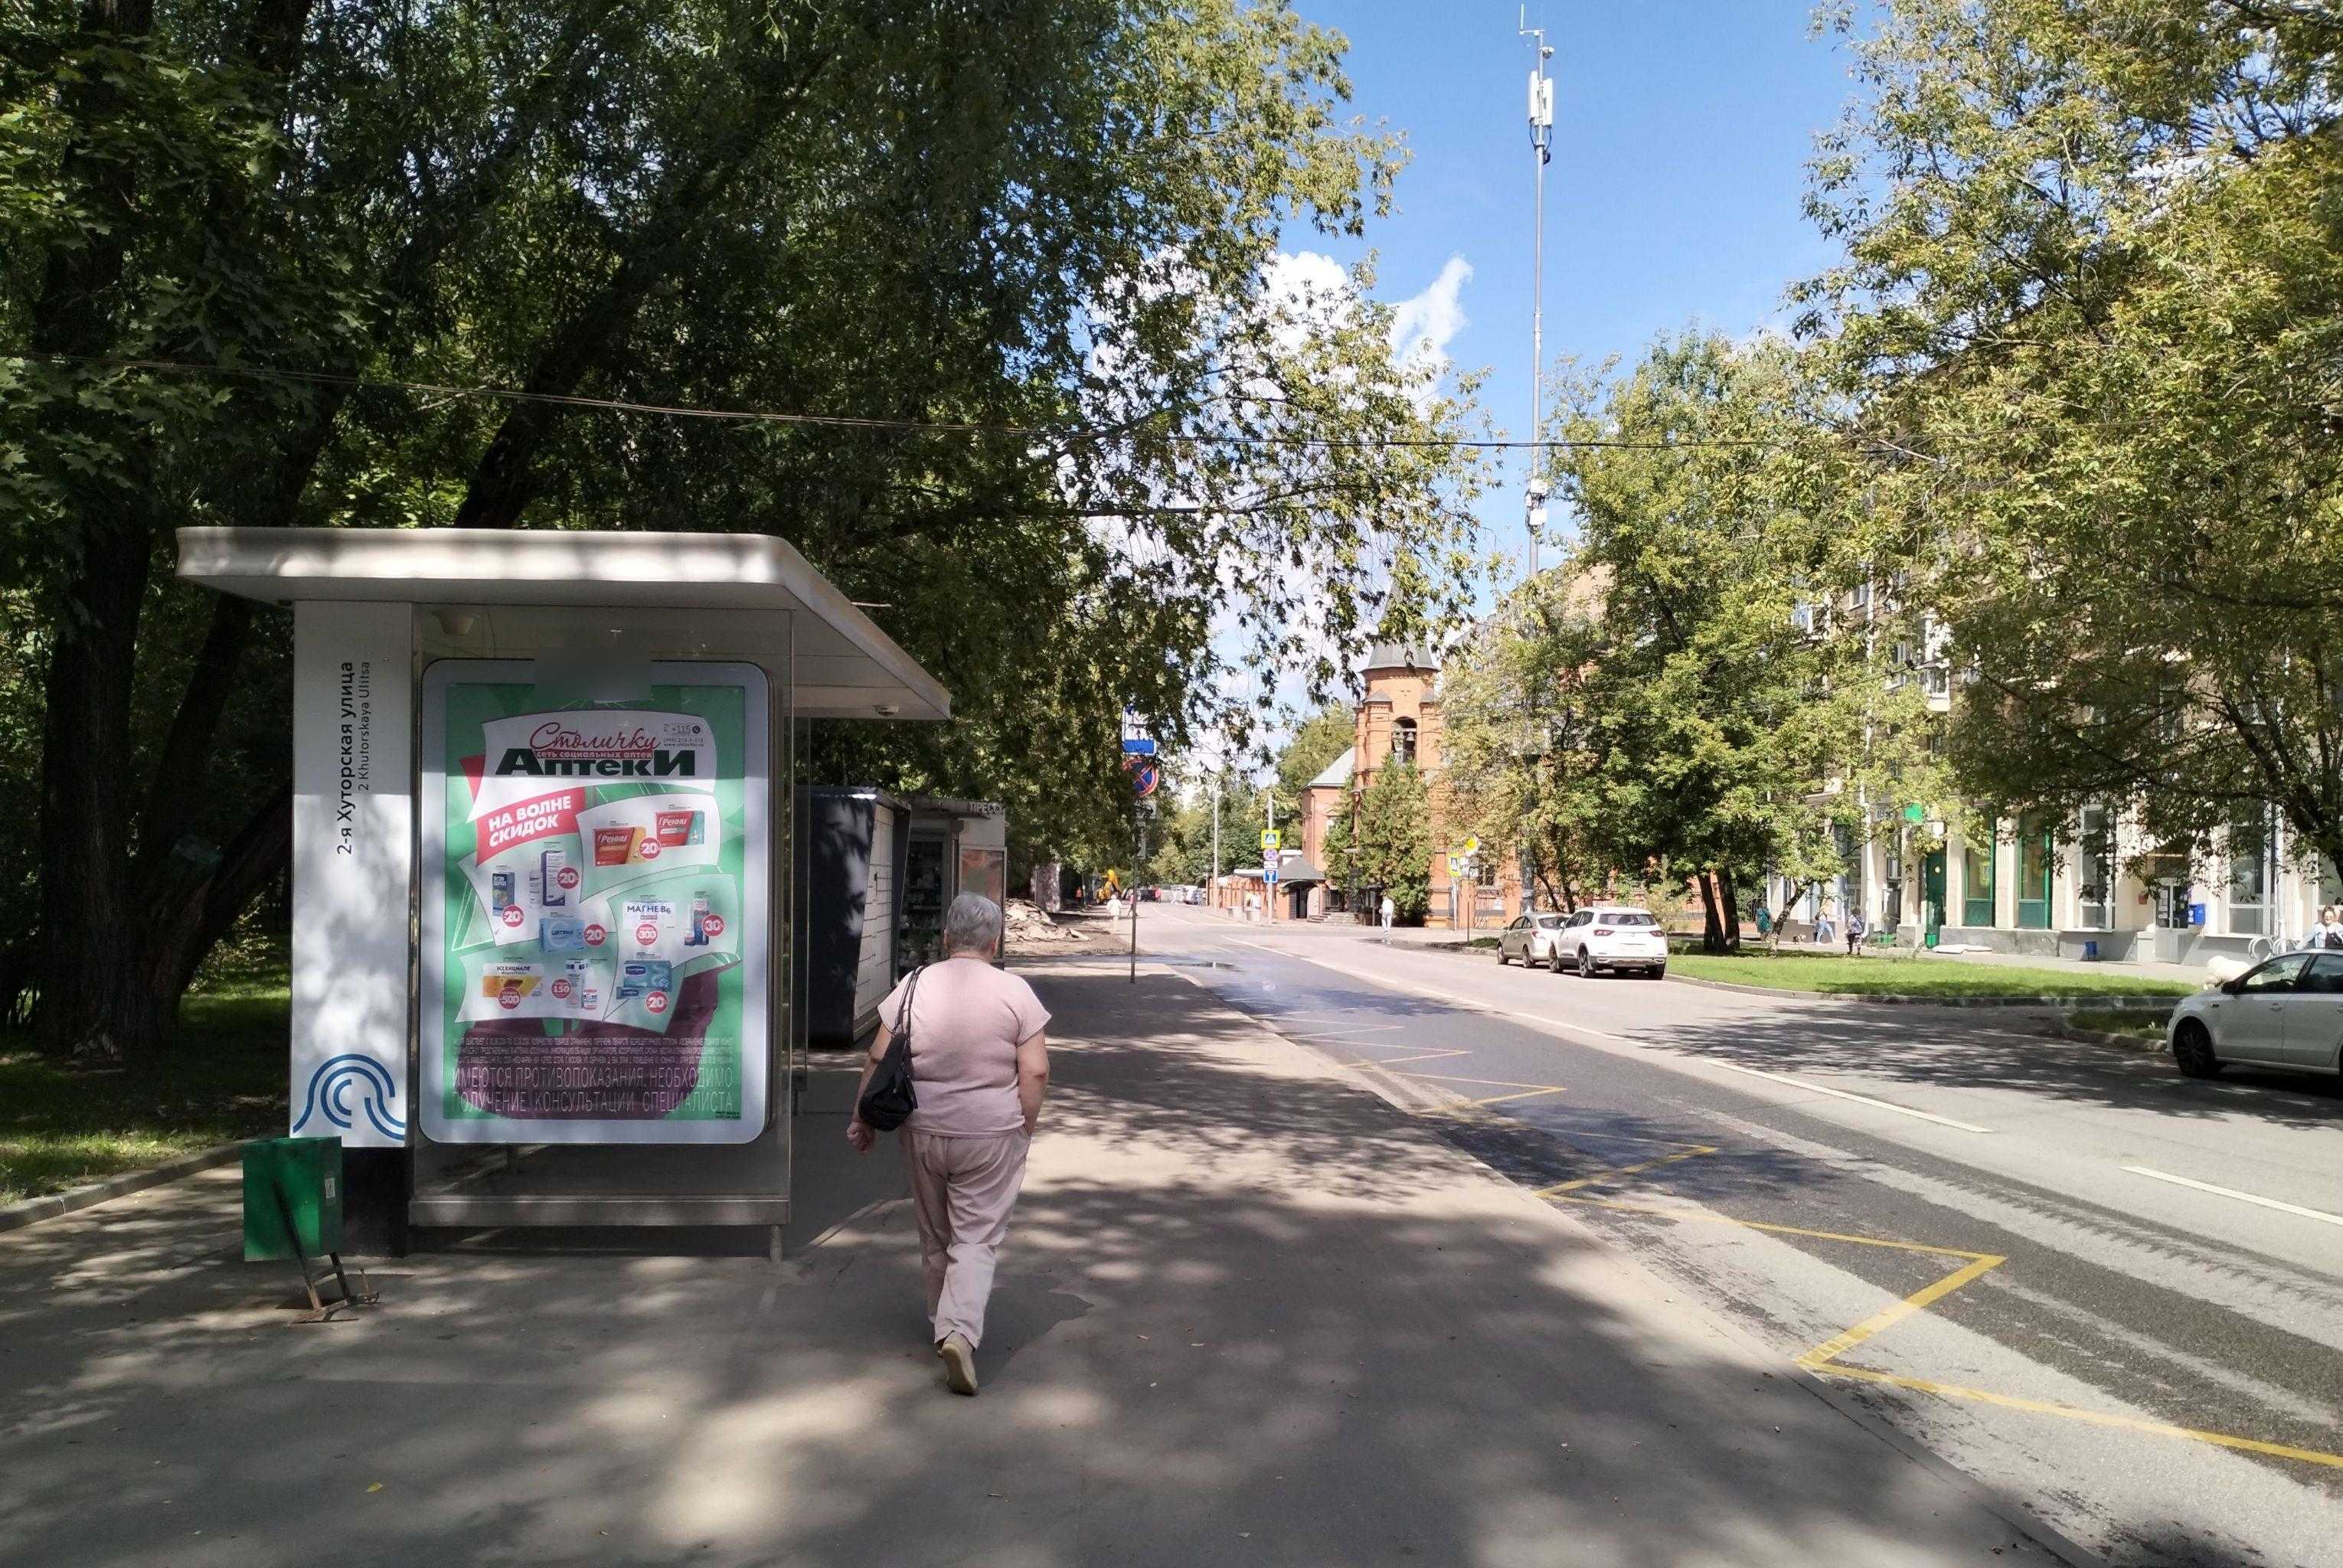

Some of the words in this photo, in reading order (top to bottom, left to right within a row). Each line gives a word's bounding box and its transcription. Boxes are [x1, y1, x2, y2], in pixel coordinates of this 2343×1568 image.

[341, 662, 357, 718] улица
[358, 662, 370, 697] Ulitsa
[358, 702, 371, 780] Khutorskaya
[529, 722, 661, 750] Столички
[559, 751, 621, 760] социальных
[337, 724, 356, 822] Хуторская
[489, 812, 513, 831] НА
[516, 795, 571, 822] ВОЛНЕ
[337, 828, 351, 855] 2-я
[489, 813, 559, 848] СКИДОК
[627, 905, 659, 913] МАГНЕ
[453, 1067, 511, 1088] ИМЕЮТСЯ
[516, 1067, 646, 1088] ПРОТИВОПОКАЗАНИЯ.
[650, 1067, 733, 1088] НЕОБХОДИМО
[453, 1091, 527, 1112] ПОЛУЧЕНИЕ
[535, 1091, 634, 1112] КОНСУЛЬТАЦИИ
[642, 1091, 733, 1112] СПЕЦИАЛИСТА
